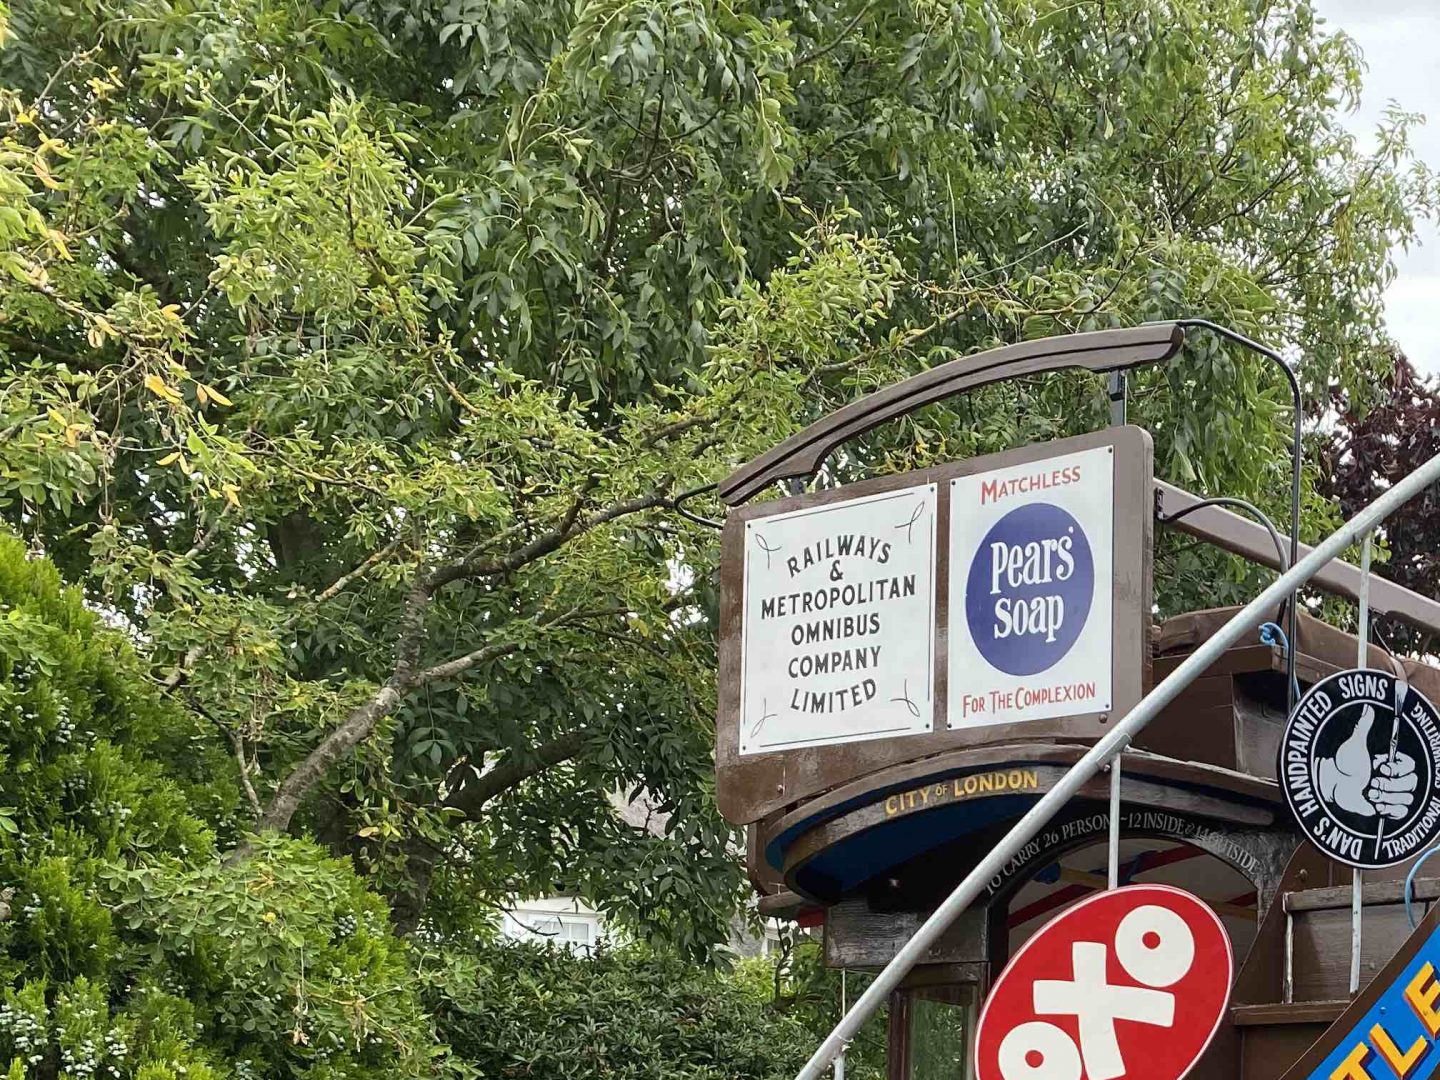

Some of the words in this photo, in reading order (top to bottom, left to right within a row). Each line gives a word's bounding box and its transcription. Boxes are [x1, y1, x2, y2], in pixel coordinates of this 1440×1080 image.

[982, 465, 1080, 505] MATCHLESS
[787, 534, 892, 578] RAILWAYS
[830, 559, 844, 581] &
[761, 575, 915, 619] METROPOLITAN
[791, 612, 880, 646] OMNIBUS
[789, 645, 881, 678] COMPANY
[791, 678, 877, 714] LIMITED
[963, 694, 985, 716] FOR
[989, 690, 1013, 713] THE
[1015, 682, 1096, 710] COMPLEXION
[1338, 673, 1388, 700] SIGNS
[1287, 690, 1333, 818] HANDPAINTED
[885, 788, 930, 815] CITY
[936, 783, 948, 796] OF
[954, 770, 1038, 797] LONDON
[1002, 839, 1040, 876] CARRY
[1043, 831, 1060, 848] 26
[1143, 812, 1185, 835] INSIDE
[1313, 816, 1363, 861] DAN'S
